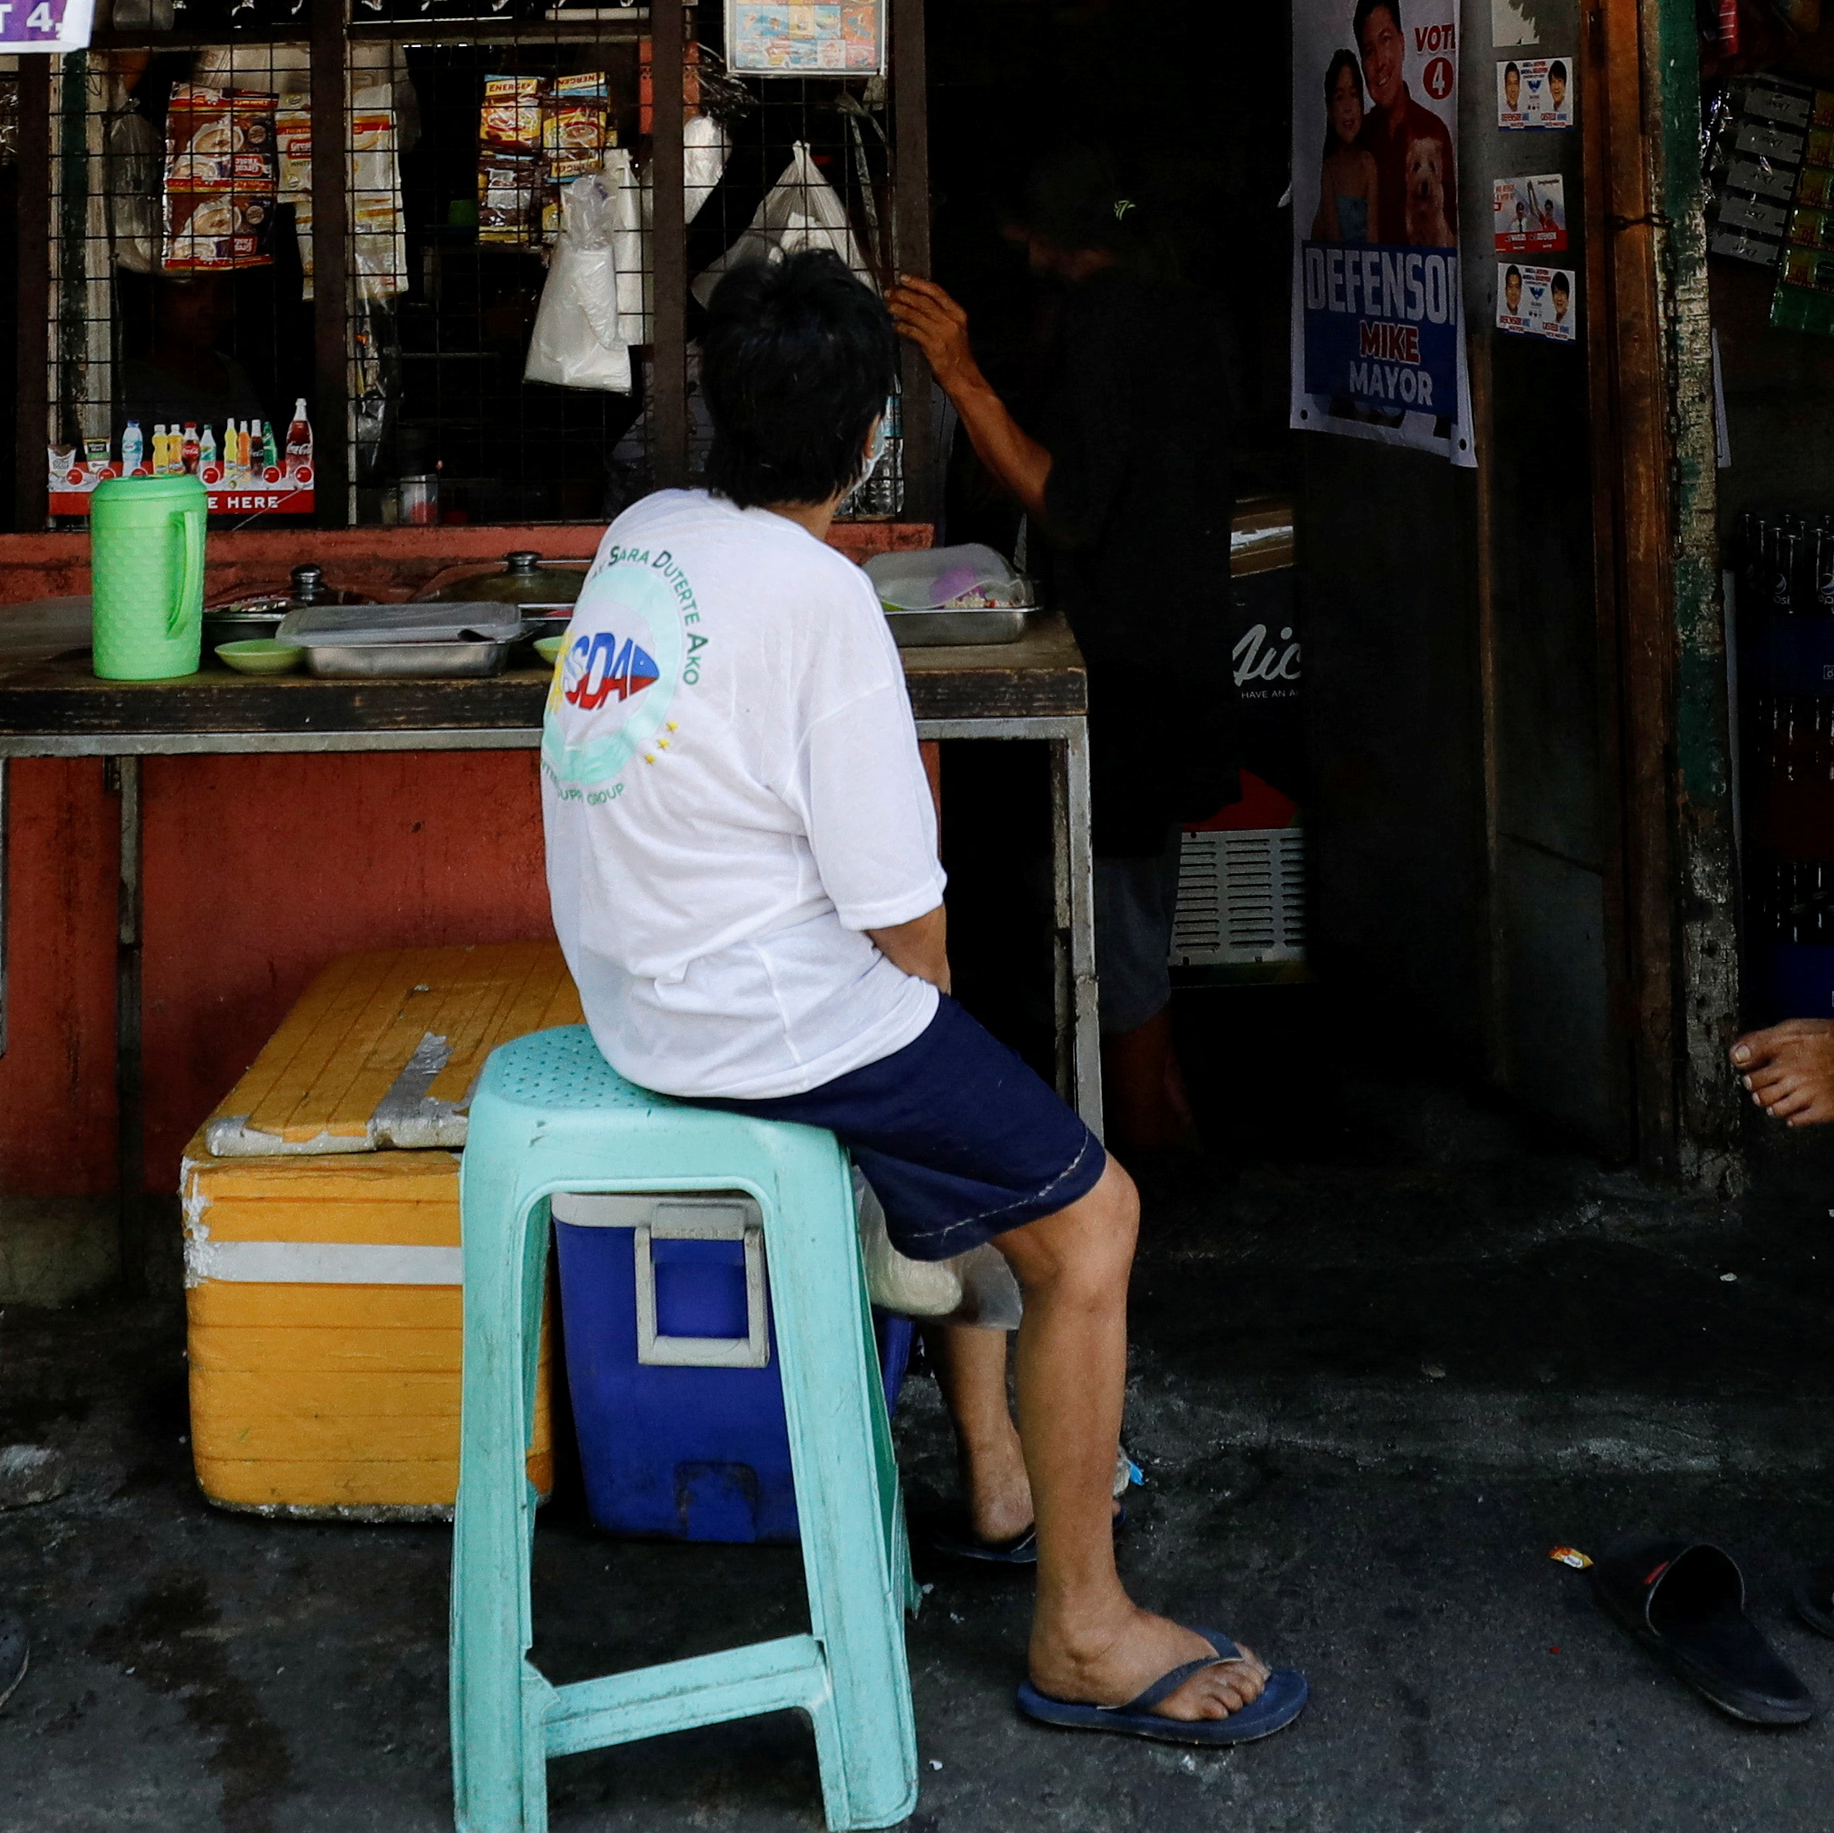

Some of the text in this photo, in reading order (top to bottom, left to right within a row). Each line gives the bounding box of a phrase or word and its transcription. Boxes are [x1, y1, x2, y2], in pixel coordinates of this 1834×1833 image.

[1358, 319, 1421, 365] MIKE
[1349, 364, 1433, 408] MAYOR
[227, 495, 278, 510] HERE
[609, 545, 709, 686] SARA DUTERTE AKO
